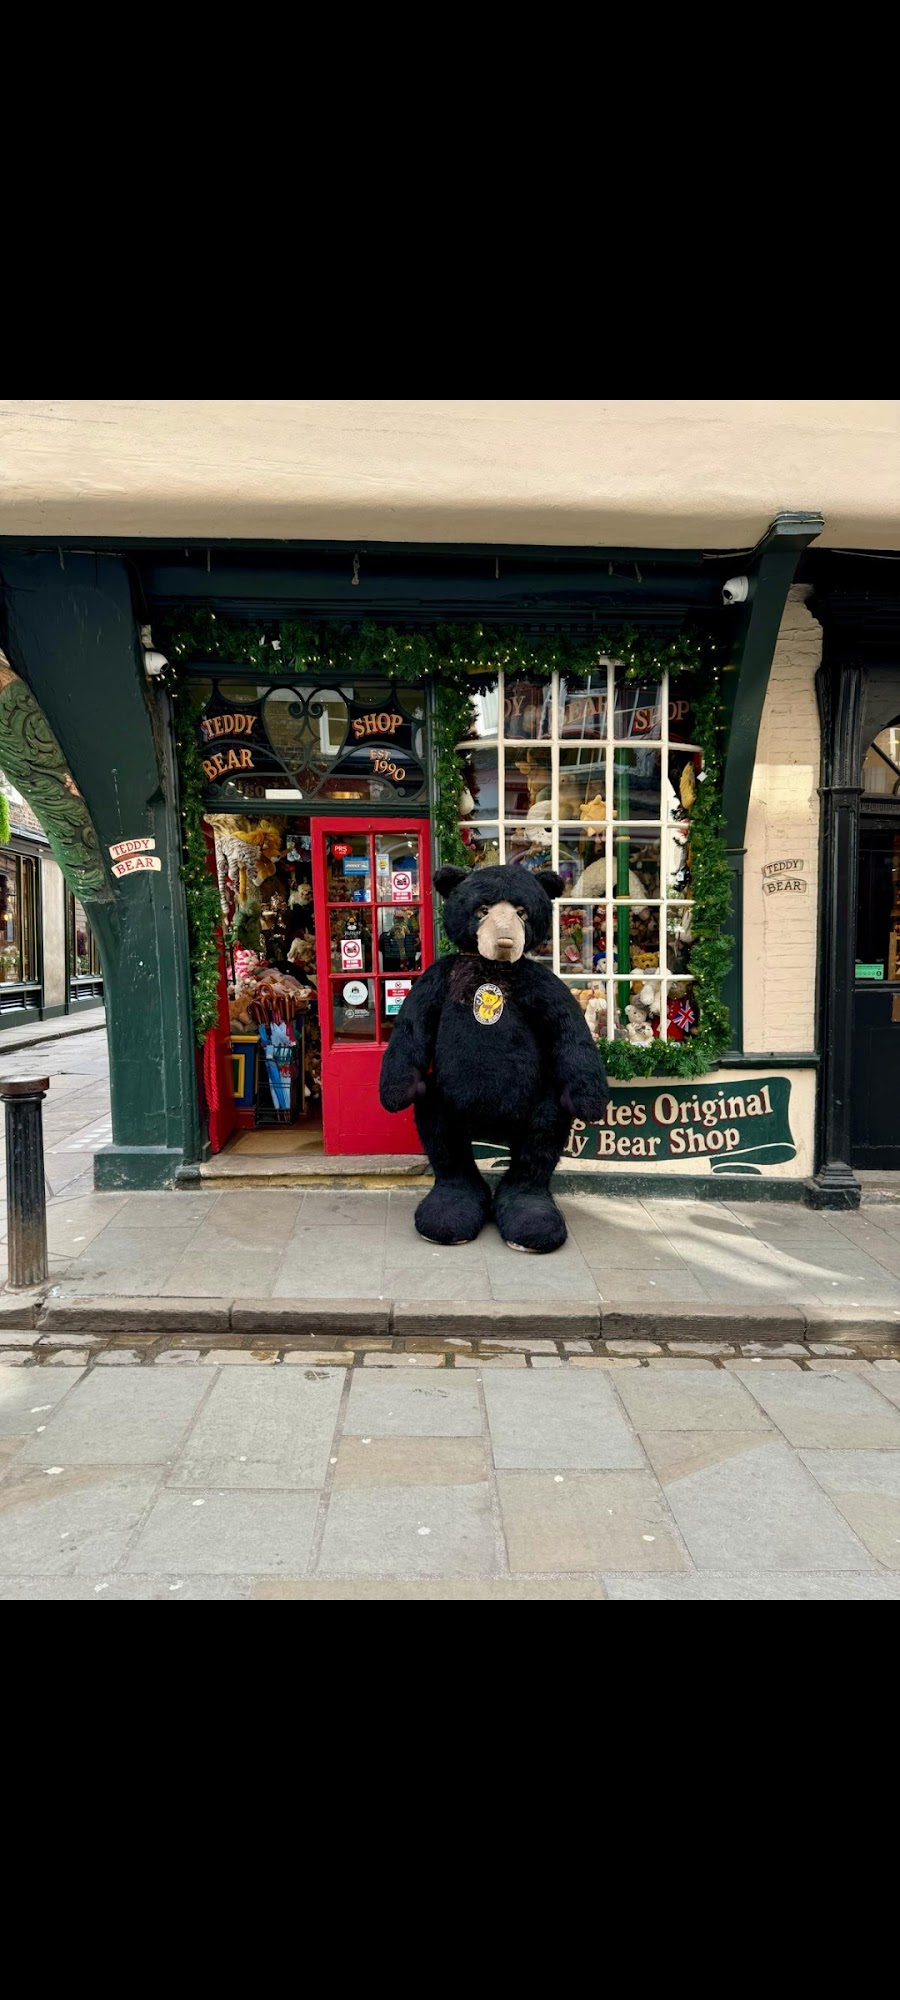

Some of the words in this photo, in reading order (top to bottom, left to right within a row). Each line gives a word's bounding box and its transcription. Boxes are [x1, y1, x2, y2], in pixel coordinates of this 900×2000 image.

[202, 713, 257, 740] TEDDY
[352, 713, 403, 739] SHOP
[635, 700, 690, 730] SHOP
[202, 749, 255, 782] BEAR
[374, 760, 406, 781] 1990
[113, 840, 149, 855] TEDDY
[334, 845, 348, 853] PRS
[116, 858, 154, 874] BEAR
[766, 860, 799, 874] TEDDY
[767, 881, 802, 893] BEAR
[654, 1085, 773, 1127] Original
[597, 1130, 661, 1156] Bear
[670, 1127, 740, 1155] Shop
